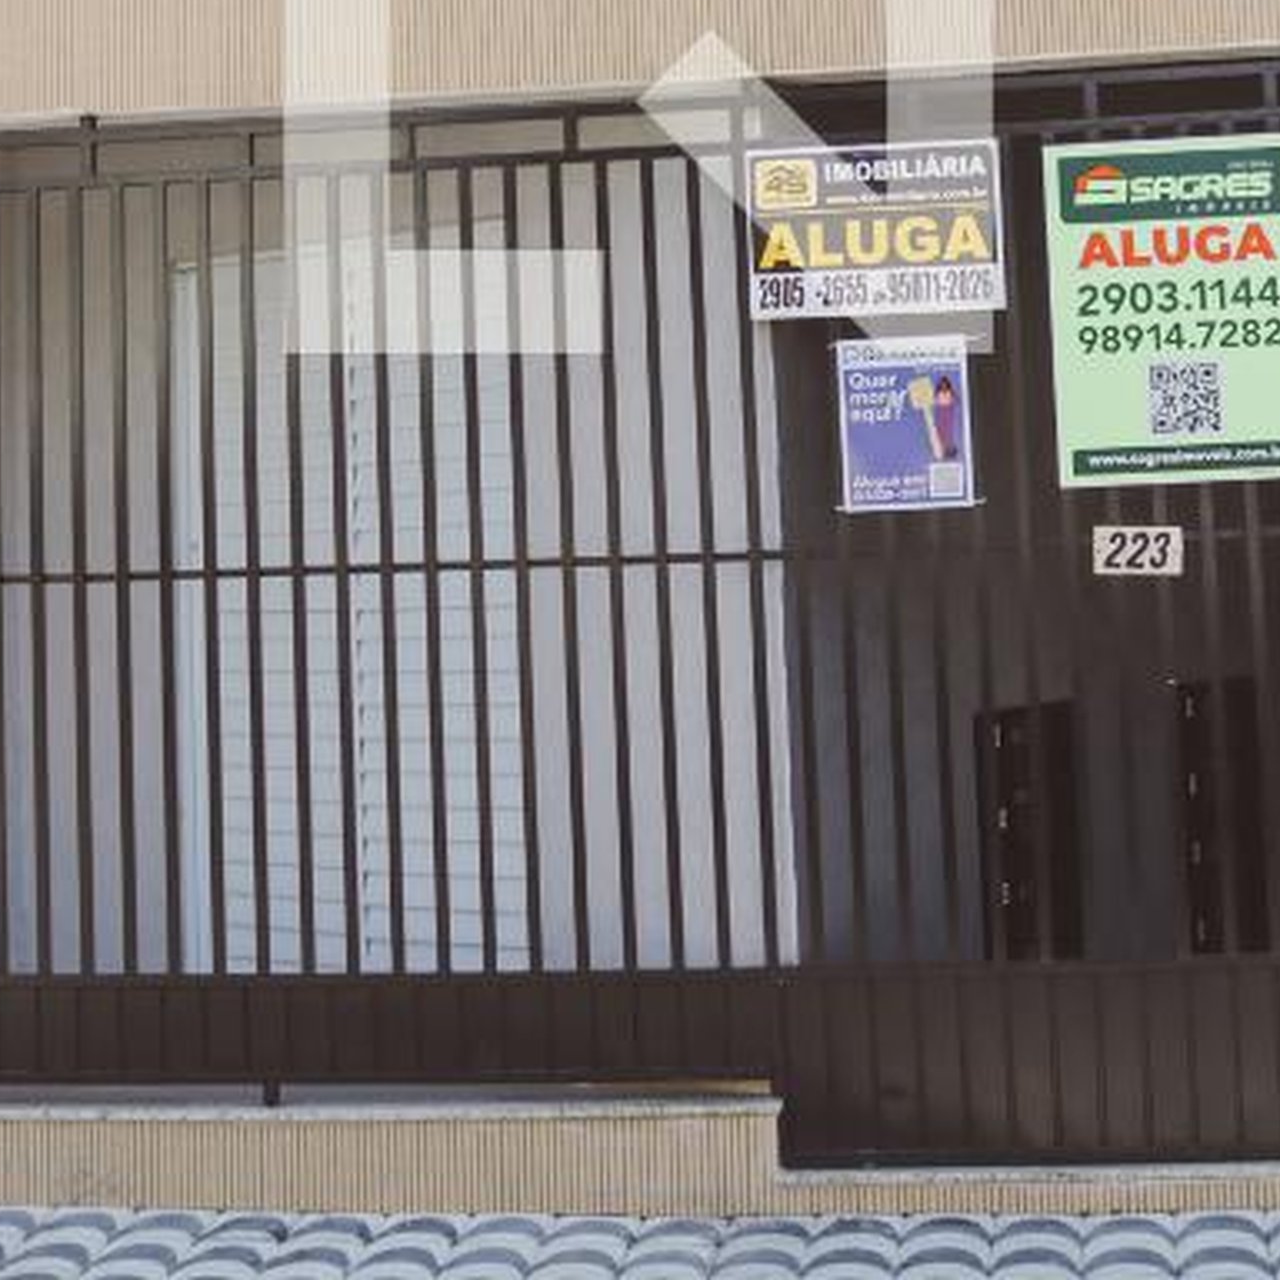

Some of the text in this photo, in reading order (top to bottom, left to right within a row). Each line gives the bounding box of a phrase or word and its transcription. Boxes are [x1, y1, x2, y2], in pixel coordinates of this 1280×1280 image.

[824, 155, 987, 182] IMOBILIÁRIA
[1130, 172, 1273, 203] SAGRES
[759, 215, 990, 269] ALUGA
[1079, 223, 1278, 268] ALUGA
[1104, 532, 1171, 569] 223
